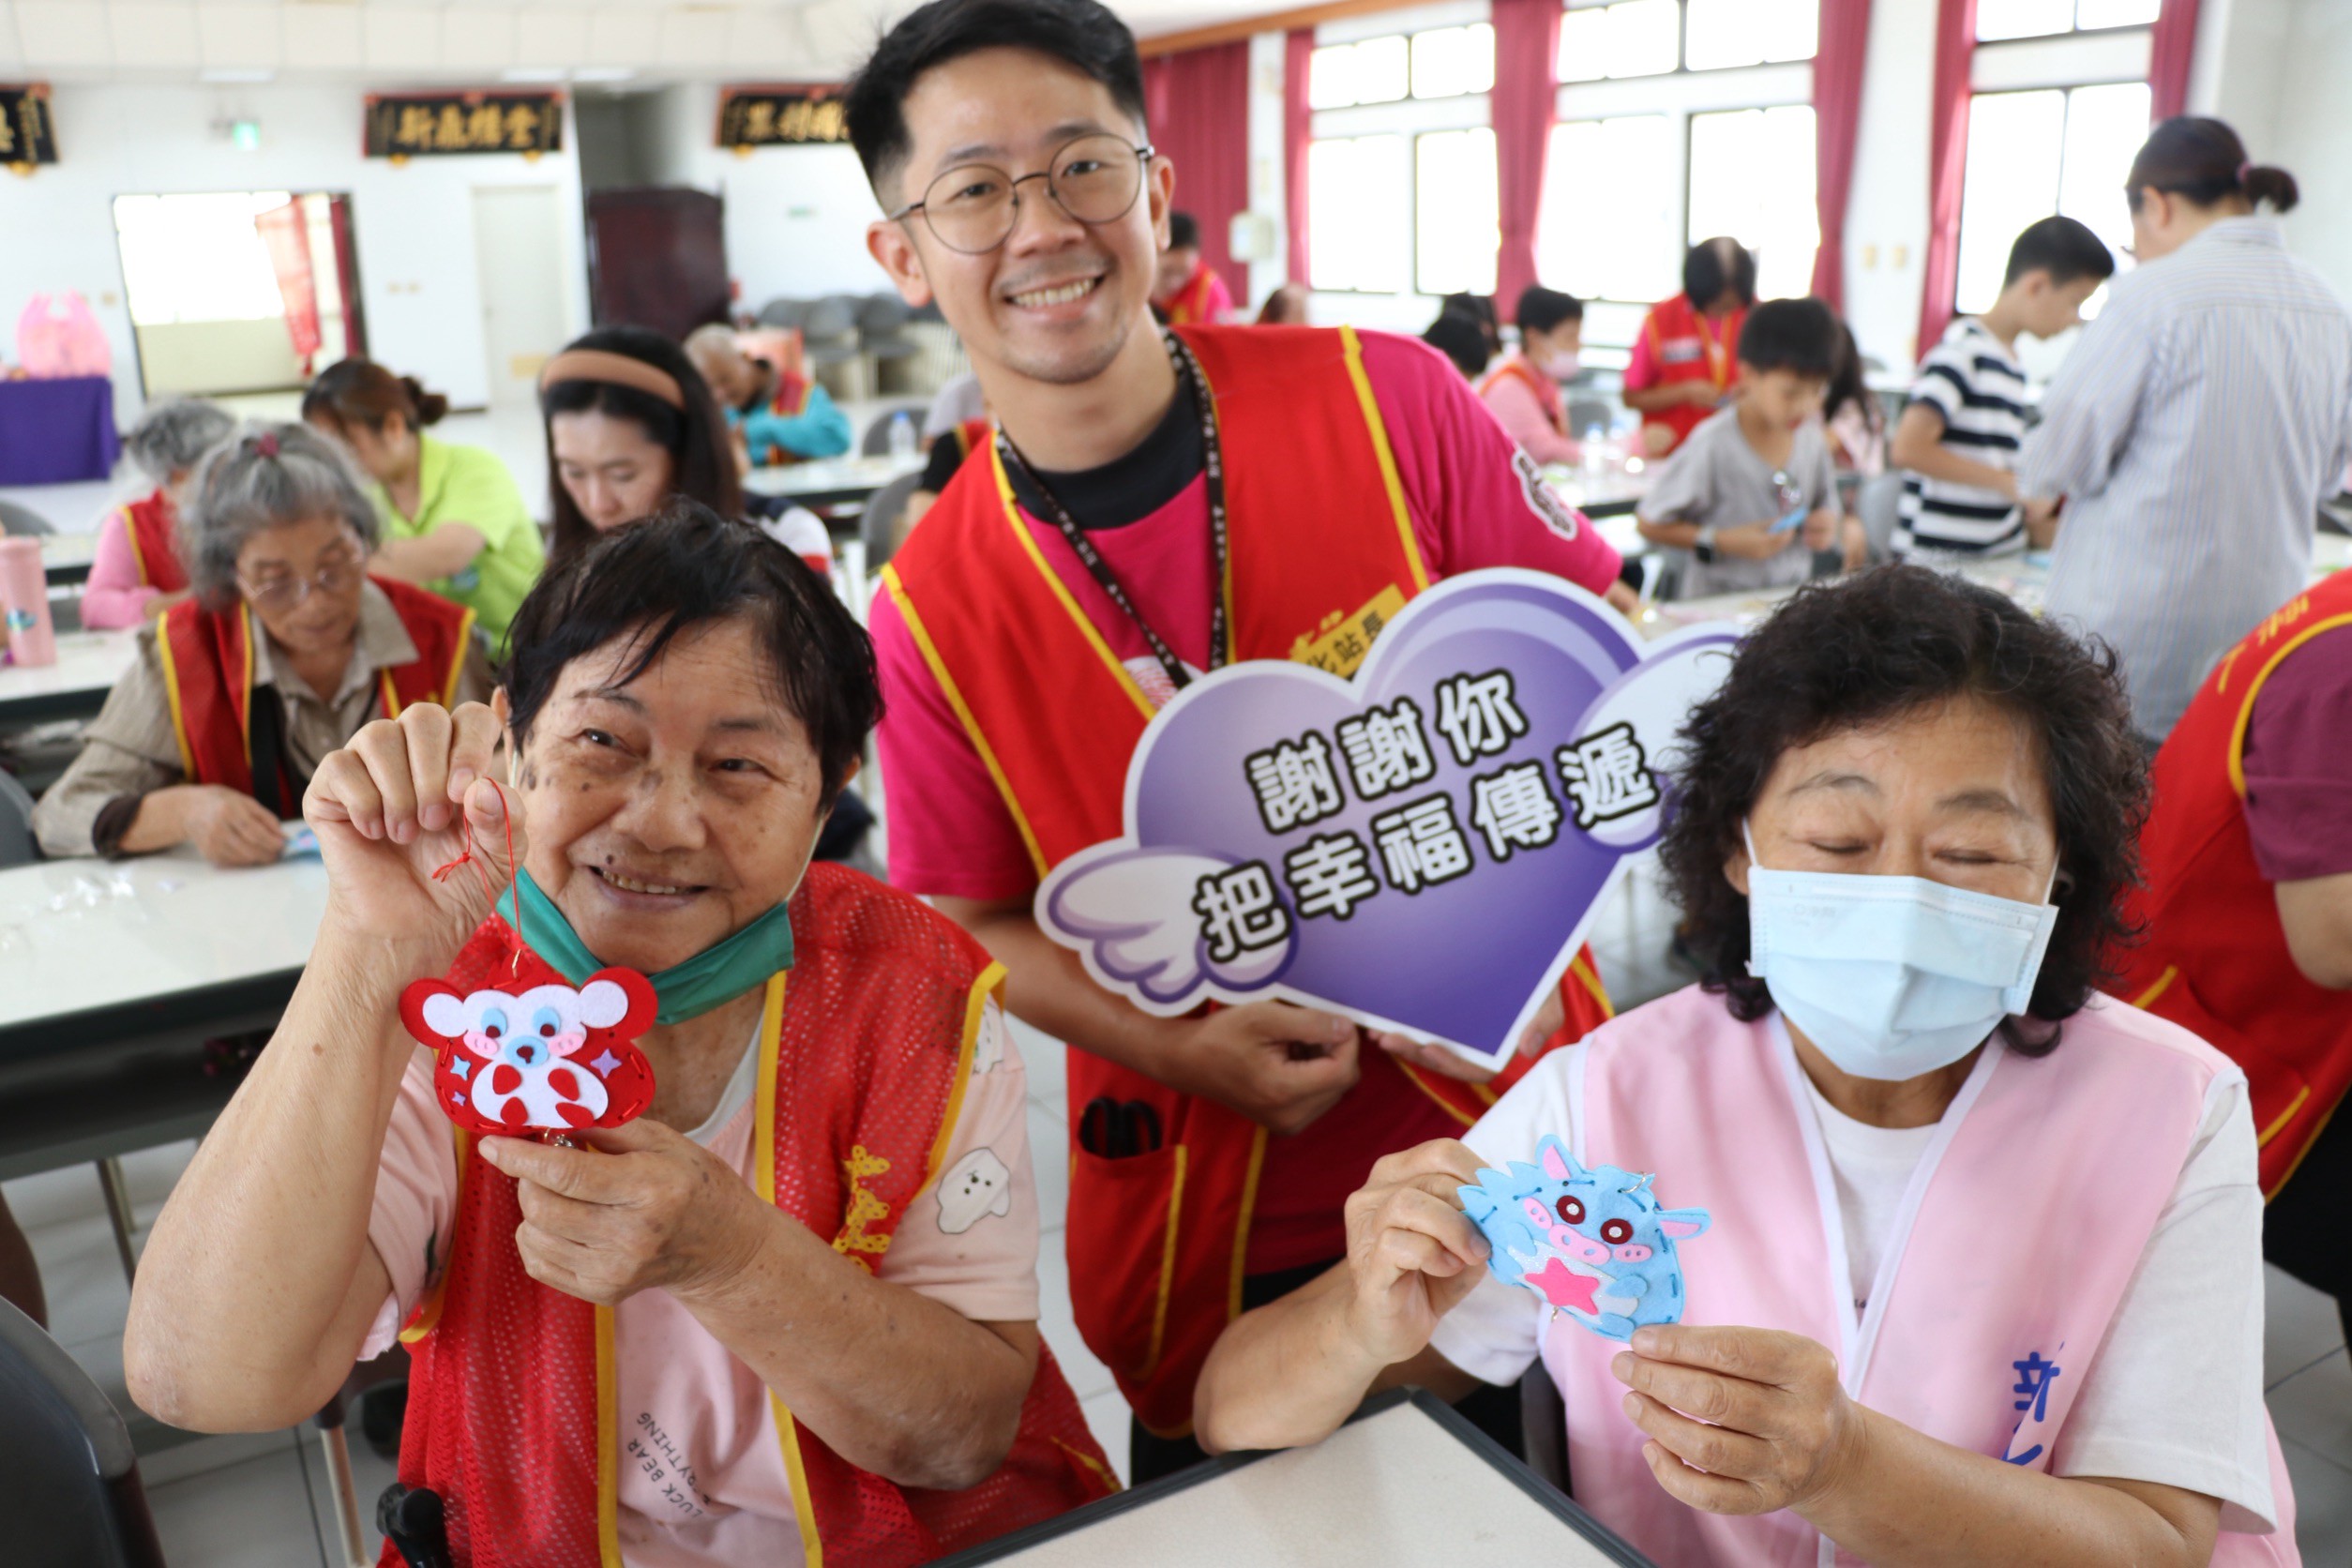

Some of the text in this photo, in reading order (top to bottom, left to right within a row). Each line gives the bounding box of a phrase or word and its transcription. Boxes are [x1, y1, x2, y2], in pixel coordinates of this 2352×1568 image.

[1244, 669, 1529, 834] 謝謝你
[1193, 721, 1659, 964] 把幸福傳遞
[626, 1438, 703, 1517] LUCK BEAR
